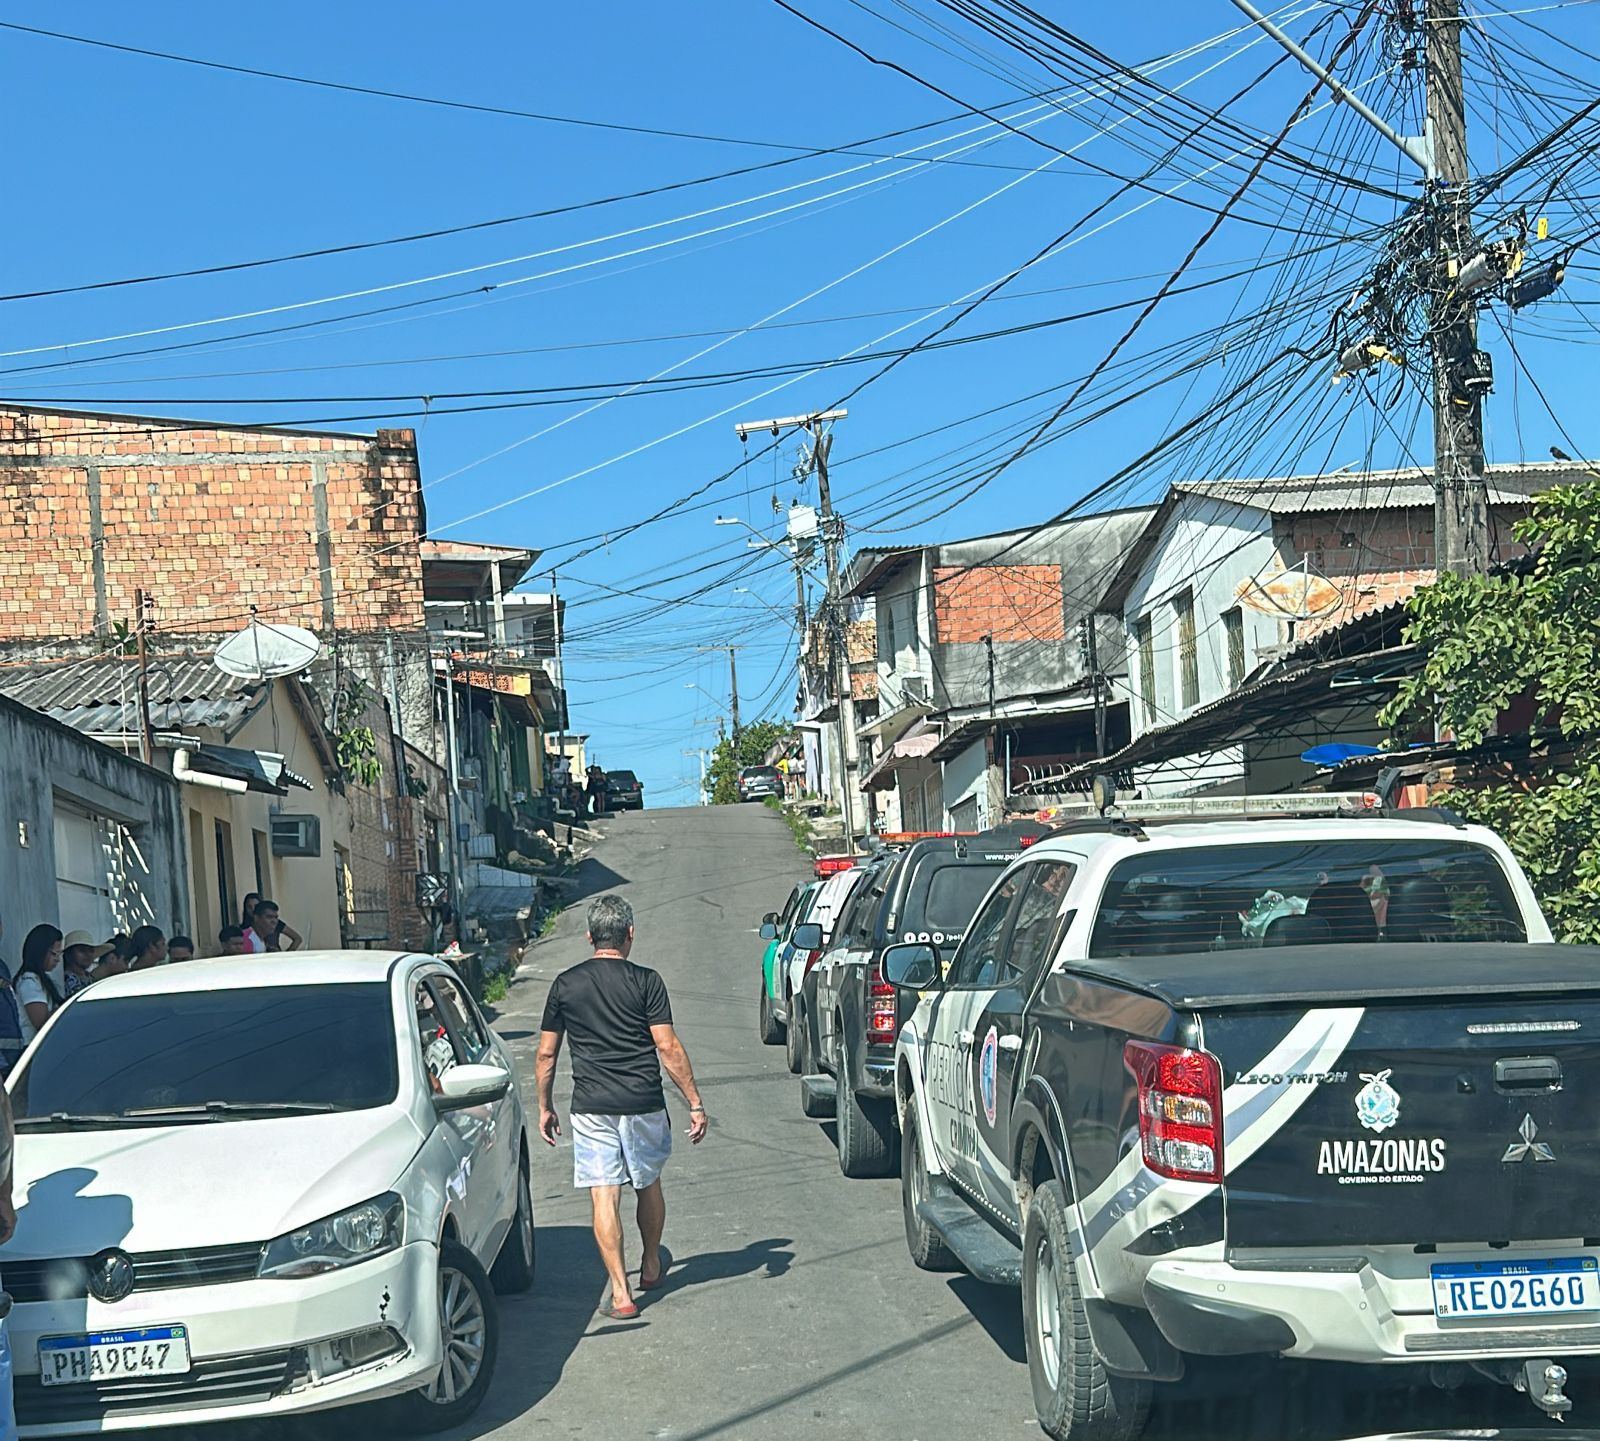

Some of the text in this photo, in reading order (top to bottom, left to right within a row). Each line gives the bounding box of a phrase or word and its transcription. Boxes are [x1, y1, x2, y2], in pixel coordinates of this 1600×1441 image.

[985, 853, 1020, 862] www.poli
[1287, 1072, 1348, 1085] TRITON
[1317, 1138, 1446, 1174] AMAZONAS
[1338, 1174, 1424, 1184] GOVERNO DO ESTADO
[1502, 1266, 1530, 1275] BRASIL
[1439, 1305, 1449, 1315] BR
[101, 1335, 125, 1344] BRASIL
[53, 1343, 170, 1379] PHA9C47
